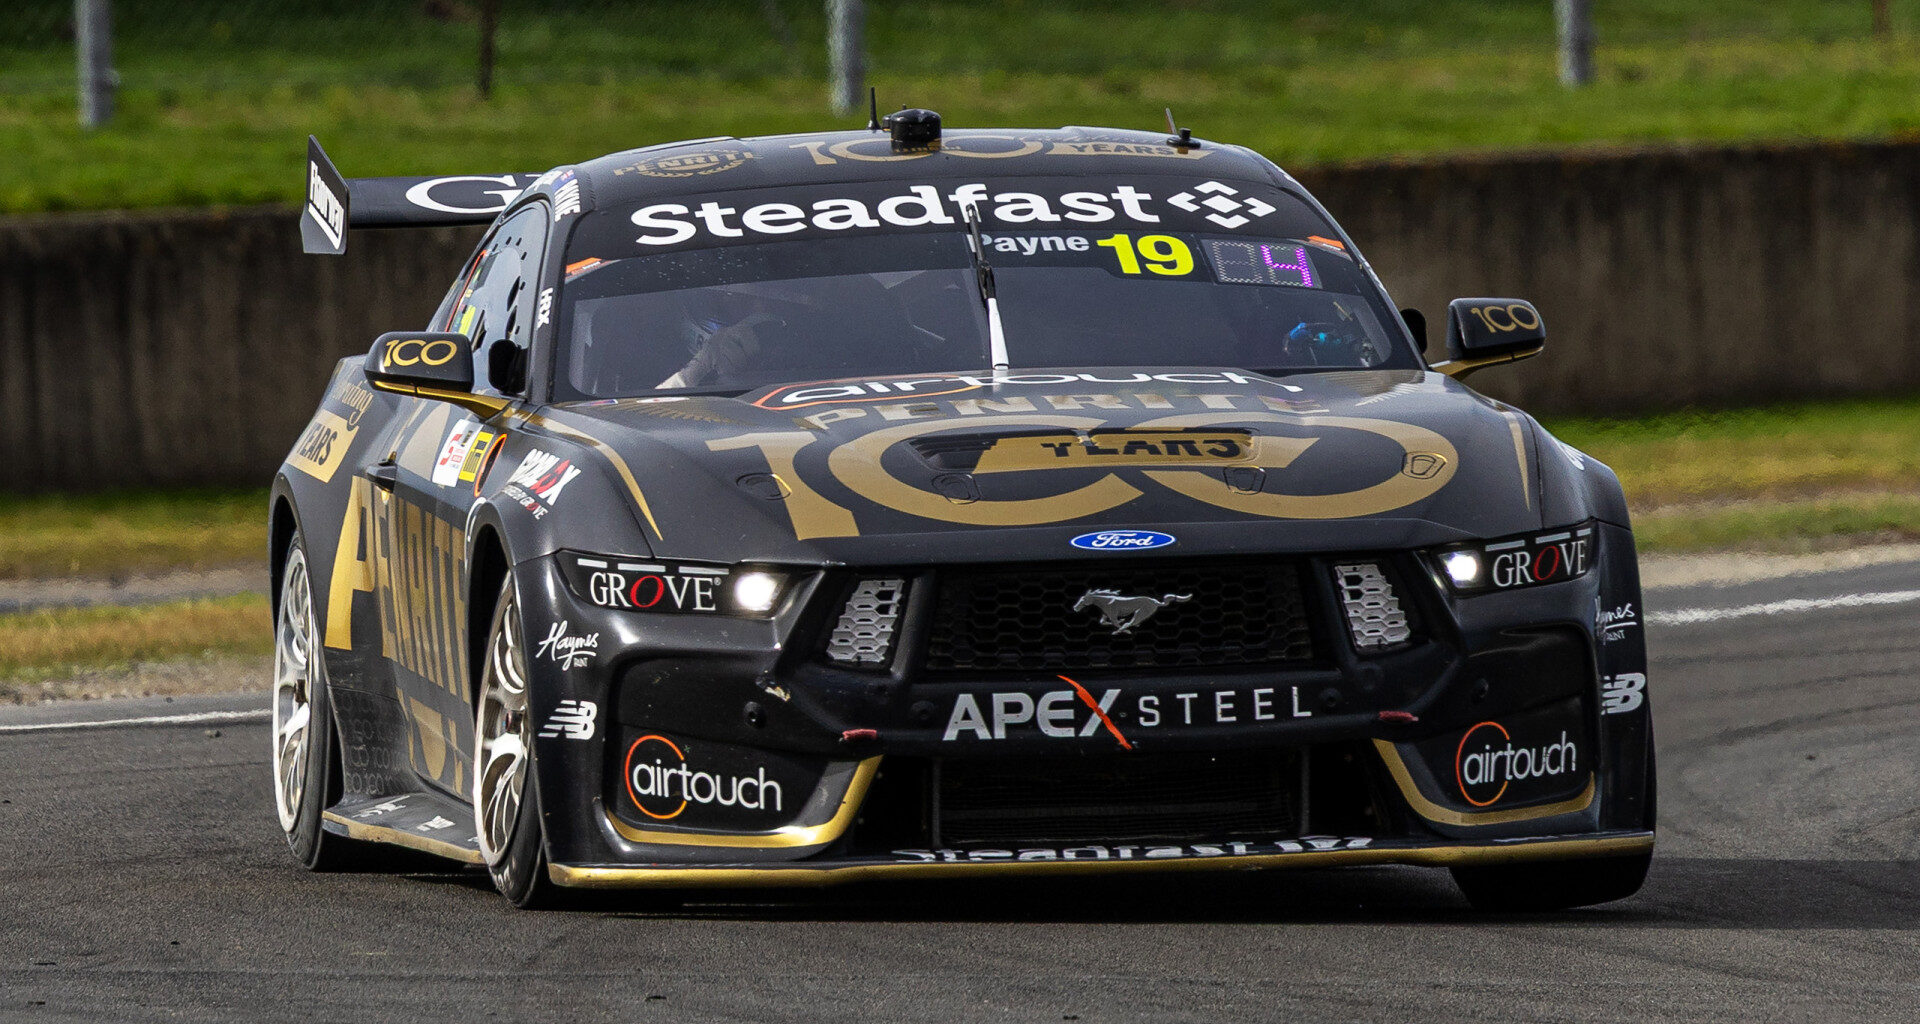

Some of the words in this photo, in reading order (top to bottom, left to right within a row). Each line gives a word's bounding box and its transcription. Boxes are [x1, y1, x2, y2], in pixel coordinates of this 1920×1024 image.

[1070, 143, 1175, 156] YEARS
[405, 175, 543, 214] G
[631, 183, 1160, 246] Steadfast
[967, 233, 1090, 257] Payne
[1097, 234, 1194, 276] 19
[536, 287, 553, 329] HRX
[1470, 304, 1539, 333] 100
[381, 339, 457, 367] 100
[783, 370, 1304, 403] airtouch
[794, 393, 1330, 430] PENRITE
[1091, 532, 1154, 547] Ford
[1493, 538, 1587, 588] GROVE
[535, 620, 600, 671] Haymes
[943, 675, 1132, 750] APEX
[1138, 686, 1312, 727] STEEL
[1463, 730, 1577, 785] airtouch
[633, 758, 782, 811] airtouch
